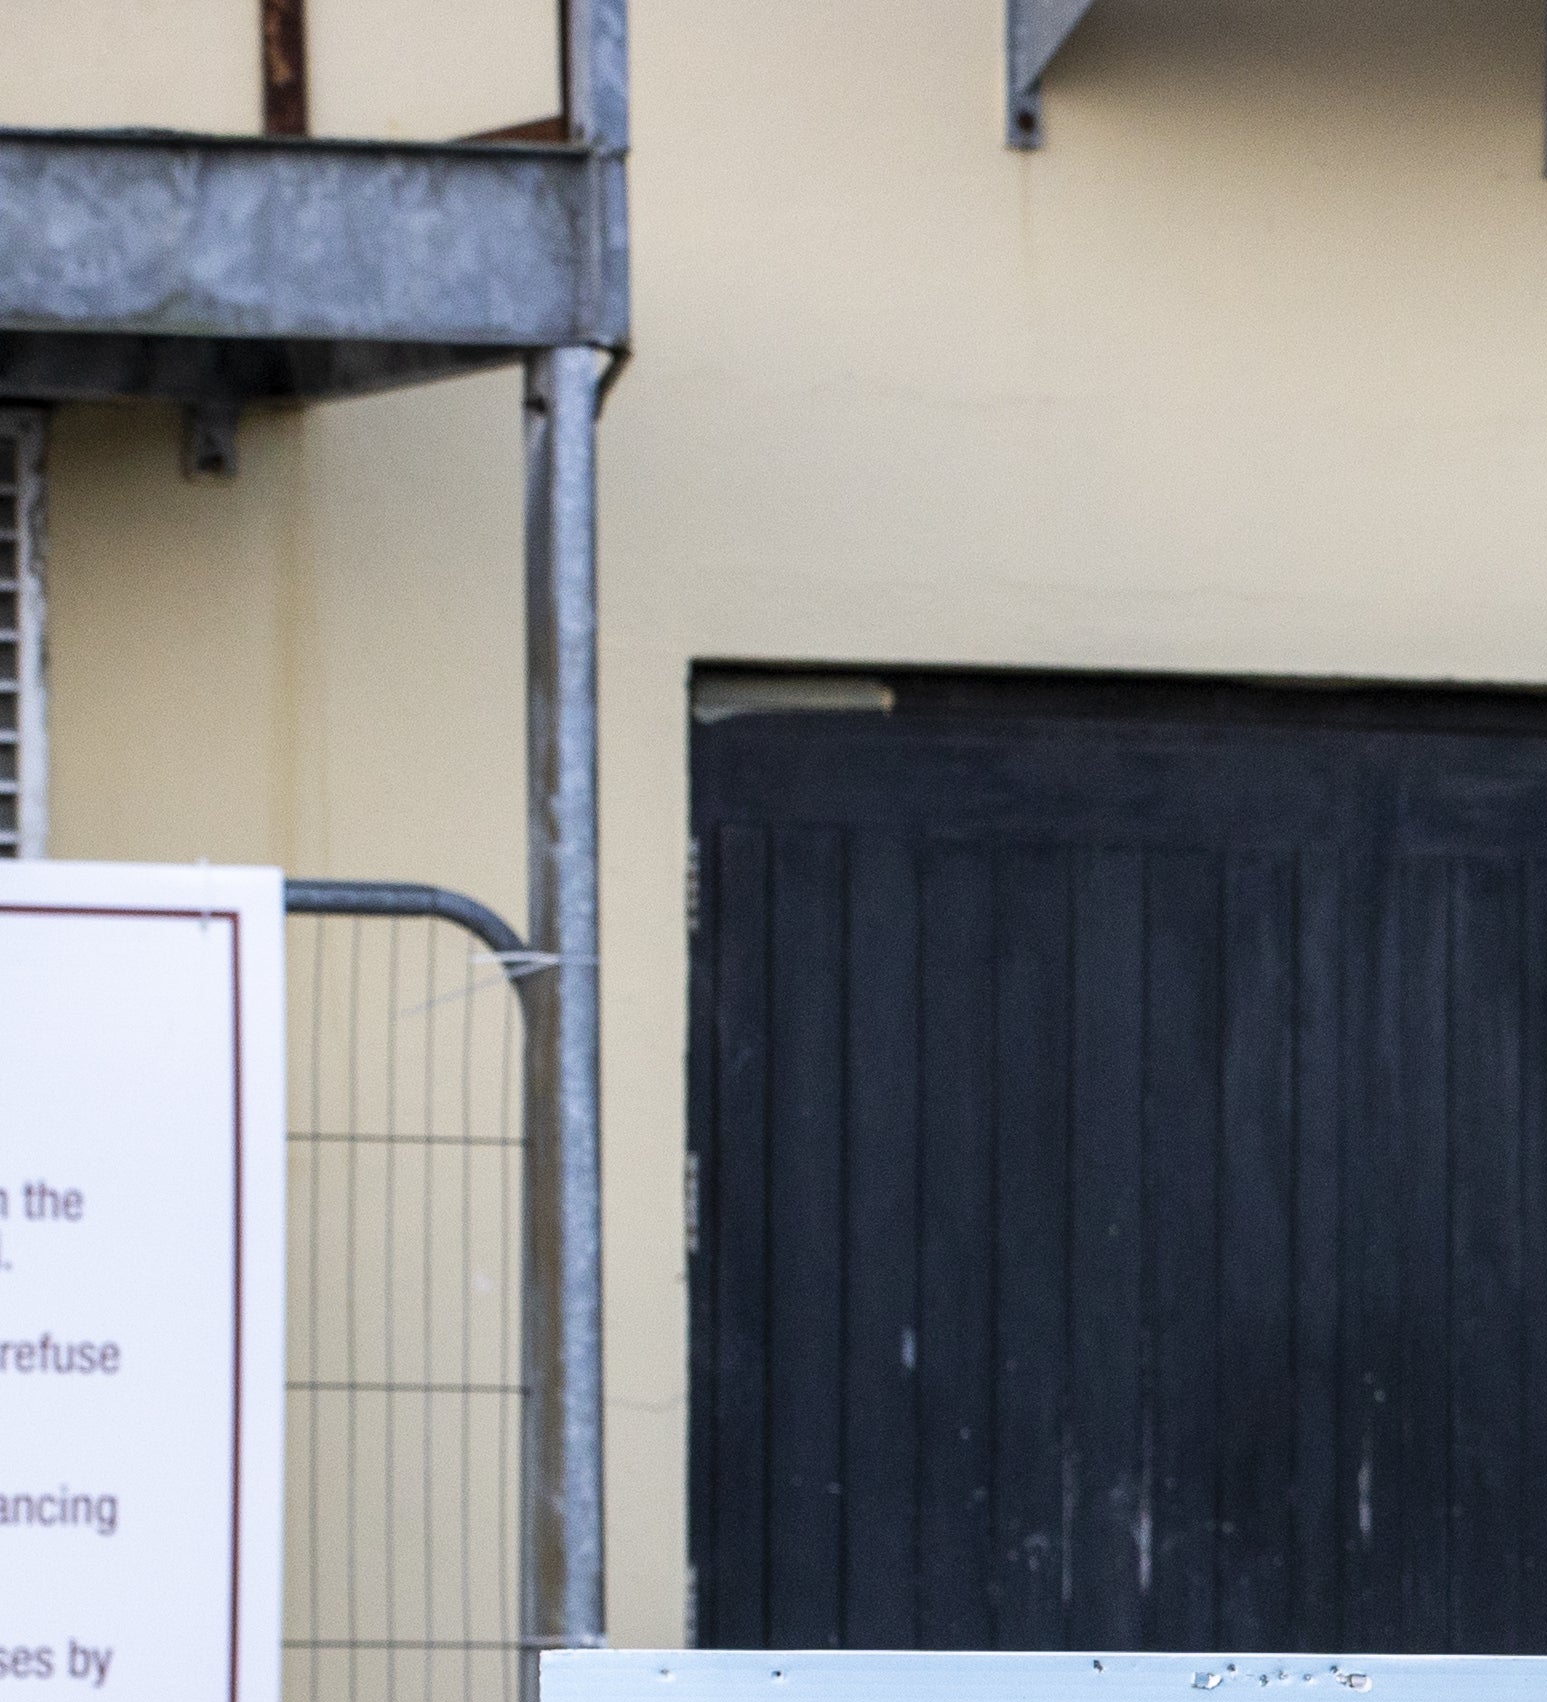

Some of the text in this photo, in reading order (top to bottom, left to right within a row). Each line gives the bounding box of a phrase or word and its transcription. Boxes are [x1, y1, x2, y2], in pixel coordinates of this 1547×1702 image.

[23, 1181, 85, 1222] the
[0, 1331, 121, 1375] refuse
[68, 1636, 115, 1689] by
